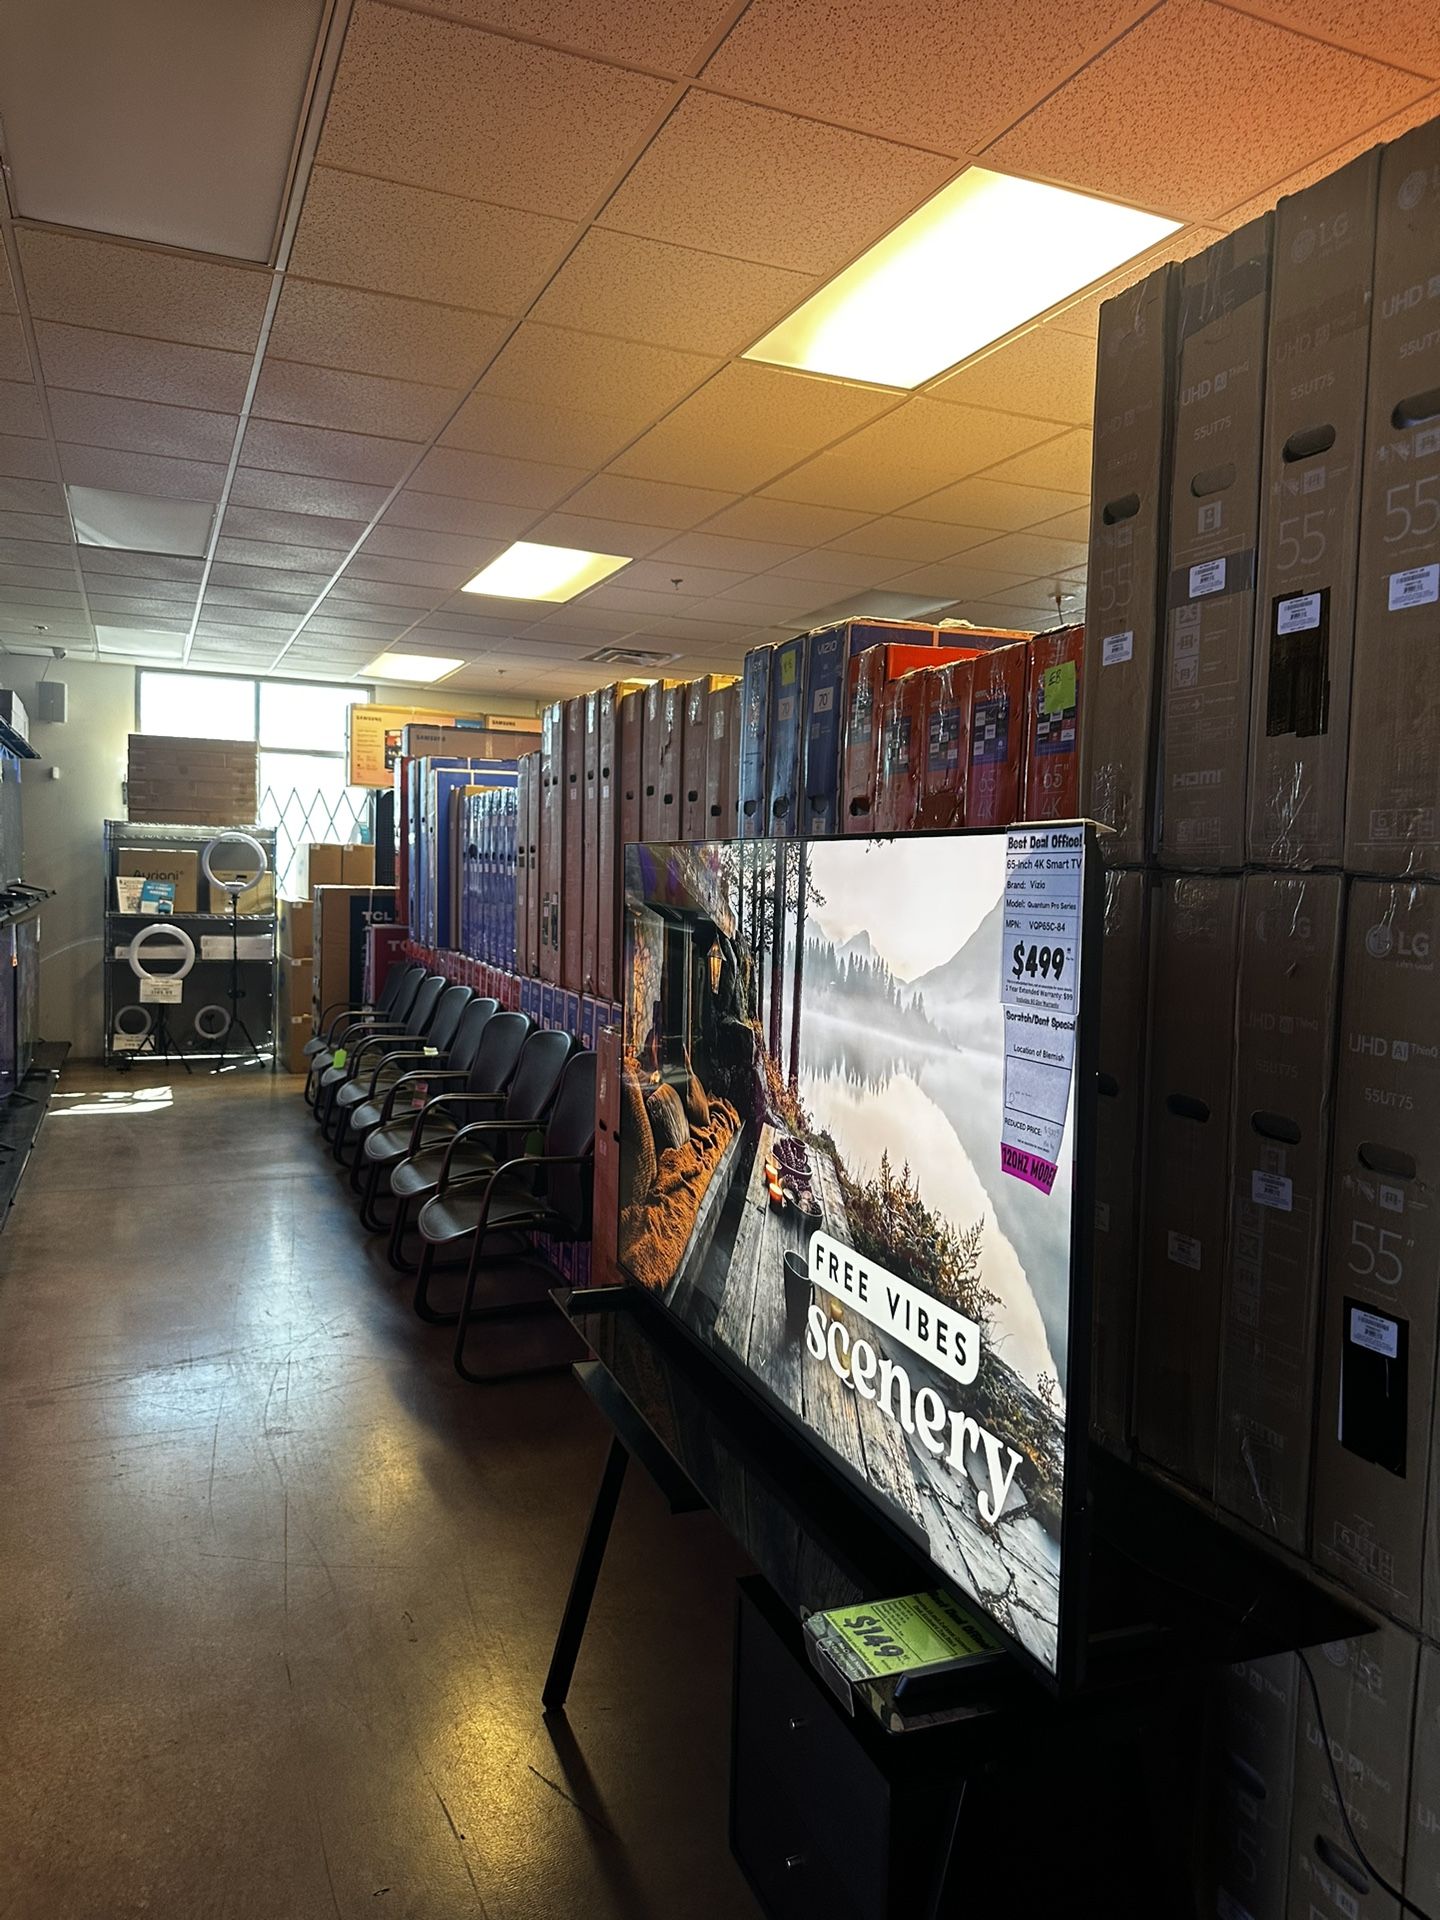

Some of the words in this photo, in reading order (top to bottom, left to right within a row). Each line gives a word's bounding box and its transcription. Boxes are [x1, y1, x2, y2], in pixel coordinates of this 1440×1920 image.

[1381, 284, 1423, 319] UHD
[1275, 330, 1312, 363] UHD
[1399, 329, 1440, 359] 55UT7
[1180, 378, 1211, 408] UHD
[1290, 370, 1336, 402] 55UT75
[1192, 415, 1232, 441] 55UT75
[817, 640, 838, 656] VIZIO
[492, 719, 516, 727] SAMSUNG
[416, 734, 446, 743] SAMSUNG
[1043, 763, 1070, 790] 65"
[977, 799, 995, 820] 4K
[1041, 796, 1062, 819] 4K
[1008, 836, 1028, 850] Best
[1030, 834, 1049, 849] Deal
[1051, 833, 1083, 849] Office!
[1034, 859, 1045, 870] 4K
[1046, 859, 1070, 870] Smart
[1071, 858, 1082, 869] TV
[1006, 880, 1026, 890] Brand:
[1030, 880, 1046, 890] Vizio
[361, 911, 392, 921] TCL
[1006, 899, 1026, 909] Model:
[1027, 900, 1051, 910] Quantum
[1051, 902, 1059, 910] Pro
[1060, 903, 1077, 911] Series
[1006, 919, 1021, 929] MPN:
[1029, 920, 1066, 932] VQP65C-84
[1398, 931, 1430, 957] LG
[1012, 940, 1066, 981] $499
[1009, 985, 1018, 993] Year
[1018, 986, 1040, 997] Extended
[1040, 989, 1062, 1001] Warranty
[1006, 1010, 1050, 1026] Scratch/Dent
[1051, 1017, 1076, 1032] Special
[1014, 1044, 1036, 1056] Location
[1036, 1049, 1043, 1057] of
[1043, 1050, 1065, 1062] Blemish
[1348, 1032, 1387, 1058] UHD
[1392, 1040, 1409, 1063] AI
[1409, 1042, 1440, 1060] ThinQ
[1364, 1087, 1415, 1111] 55UT75
[1004, 1117, 1027, 1132] REDUCED
[1027, 1123, 1043, 1137] PRICE:
[1002, 1147, 1030, 1174] 120HZ
[1347, 1219, 1416, 1286] 55"
[816, 1244, 869, 1303] FREE
[887, 1287, 968, 1367] VIBES
[806, 1304, 1023, 1524] scenery
[843, 1615, 904, 1658] $149
